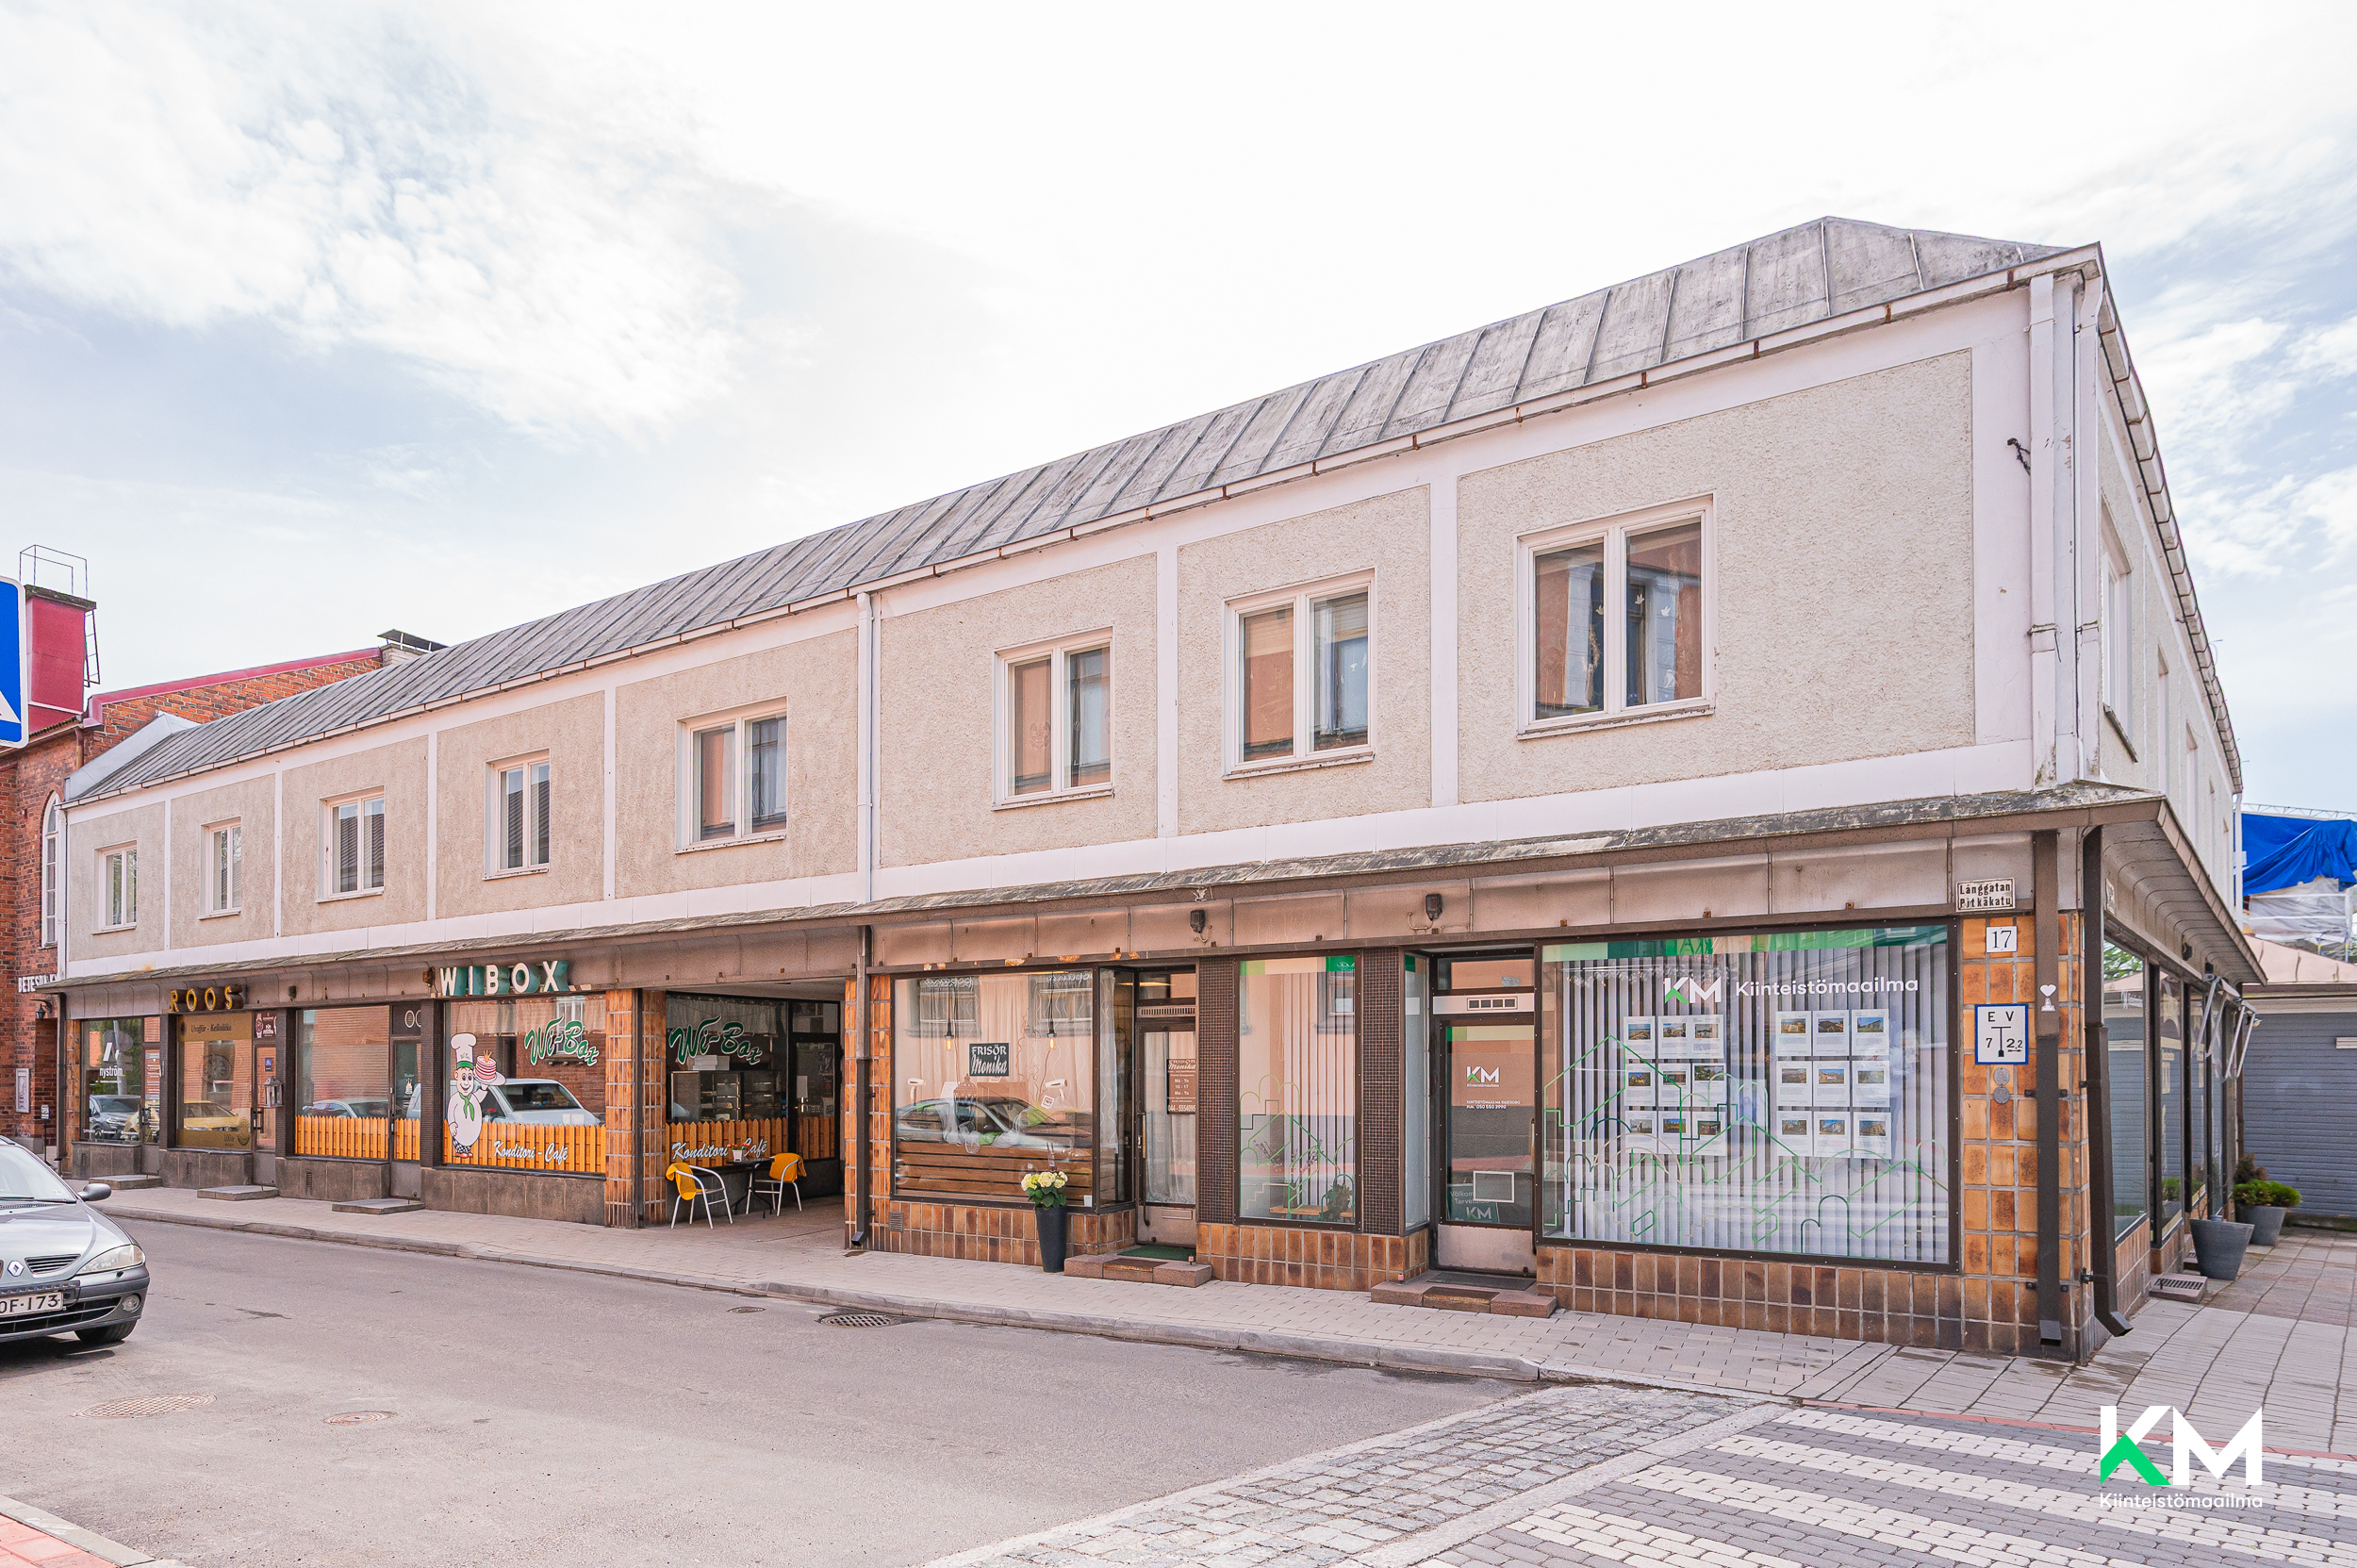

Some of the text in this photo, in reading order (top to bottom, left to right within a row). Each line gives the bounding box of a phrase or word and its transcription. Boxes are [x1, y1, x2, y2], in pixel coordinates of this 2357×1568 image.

[1960, 883, 2011, 896] Långgatan
[1960, 897, 2011, 908] Pitkäkatu
[1991, 930, 2012, 949] 17
[440, 961, 561, 997] WIBOX
[170, 985, 233, 1012] ROOS
[1664, 976, 1919, 1003] KM Kiinteistömaailma
[1987, 1011, 2014, 1022] E V
[971, 1044, 1007, 1056] FRISÖR
[1986, 1038, 1992, 1048] 7
[971, 1053, 1008, 1075] Monika
[1466, 1066, 1500, 1083] KM
[493, 1140, 536, 1159] Konditori
[545, 1142, 569, 1165] Café
[671, 1141, 729, 1160] Konditori
[1466, 1207, 1492, 1219] KM
